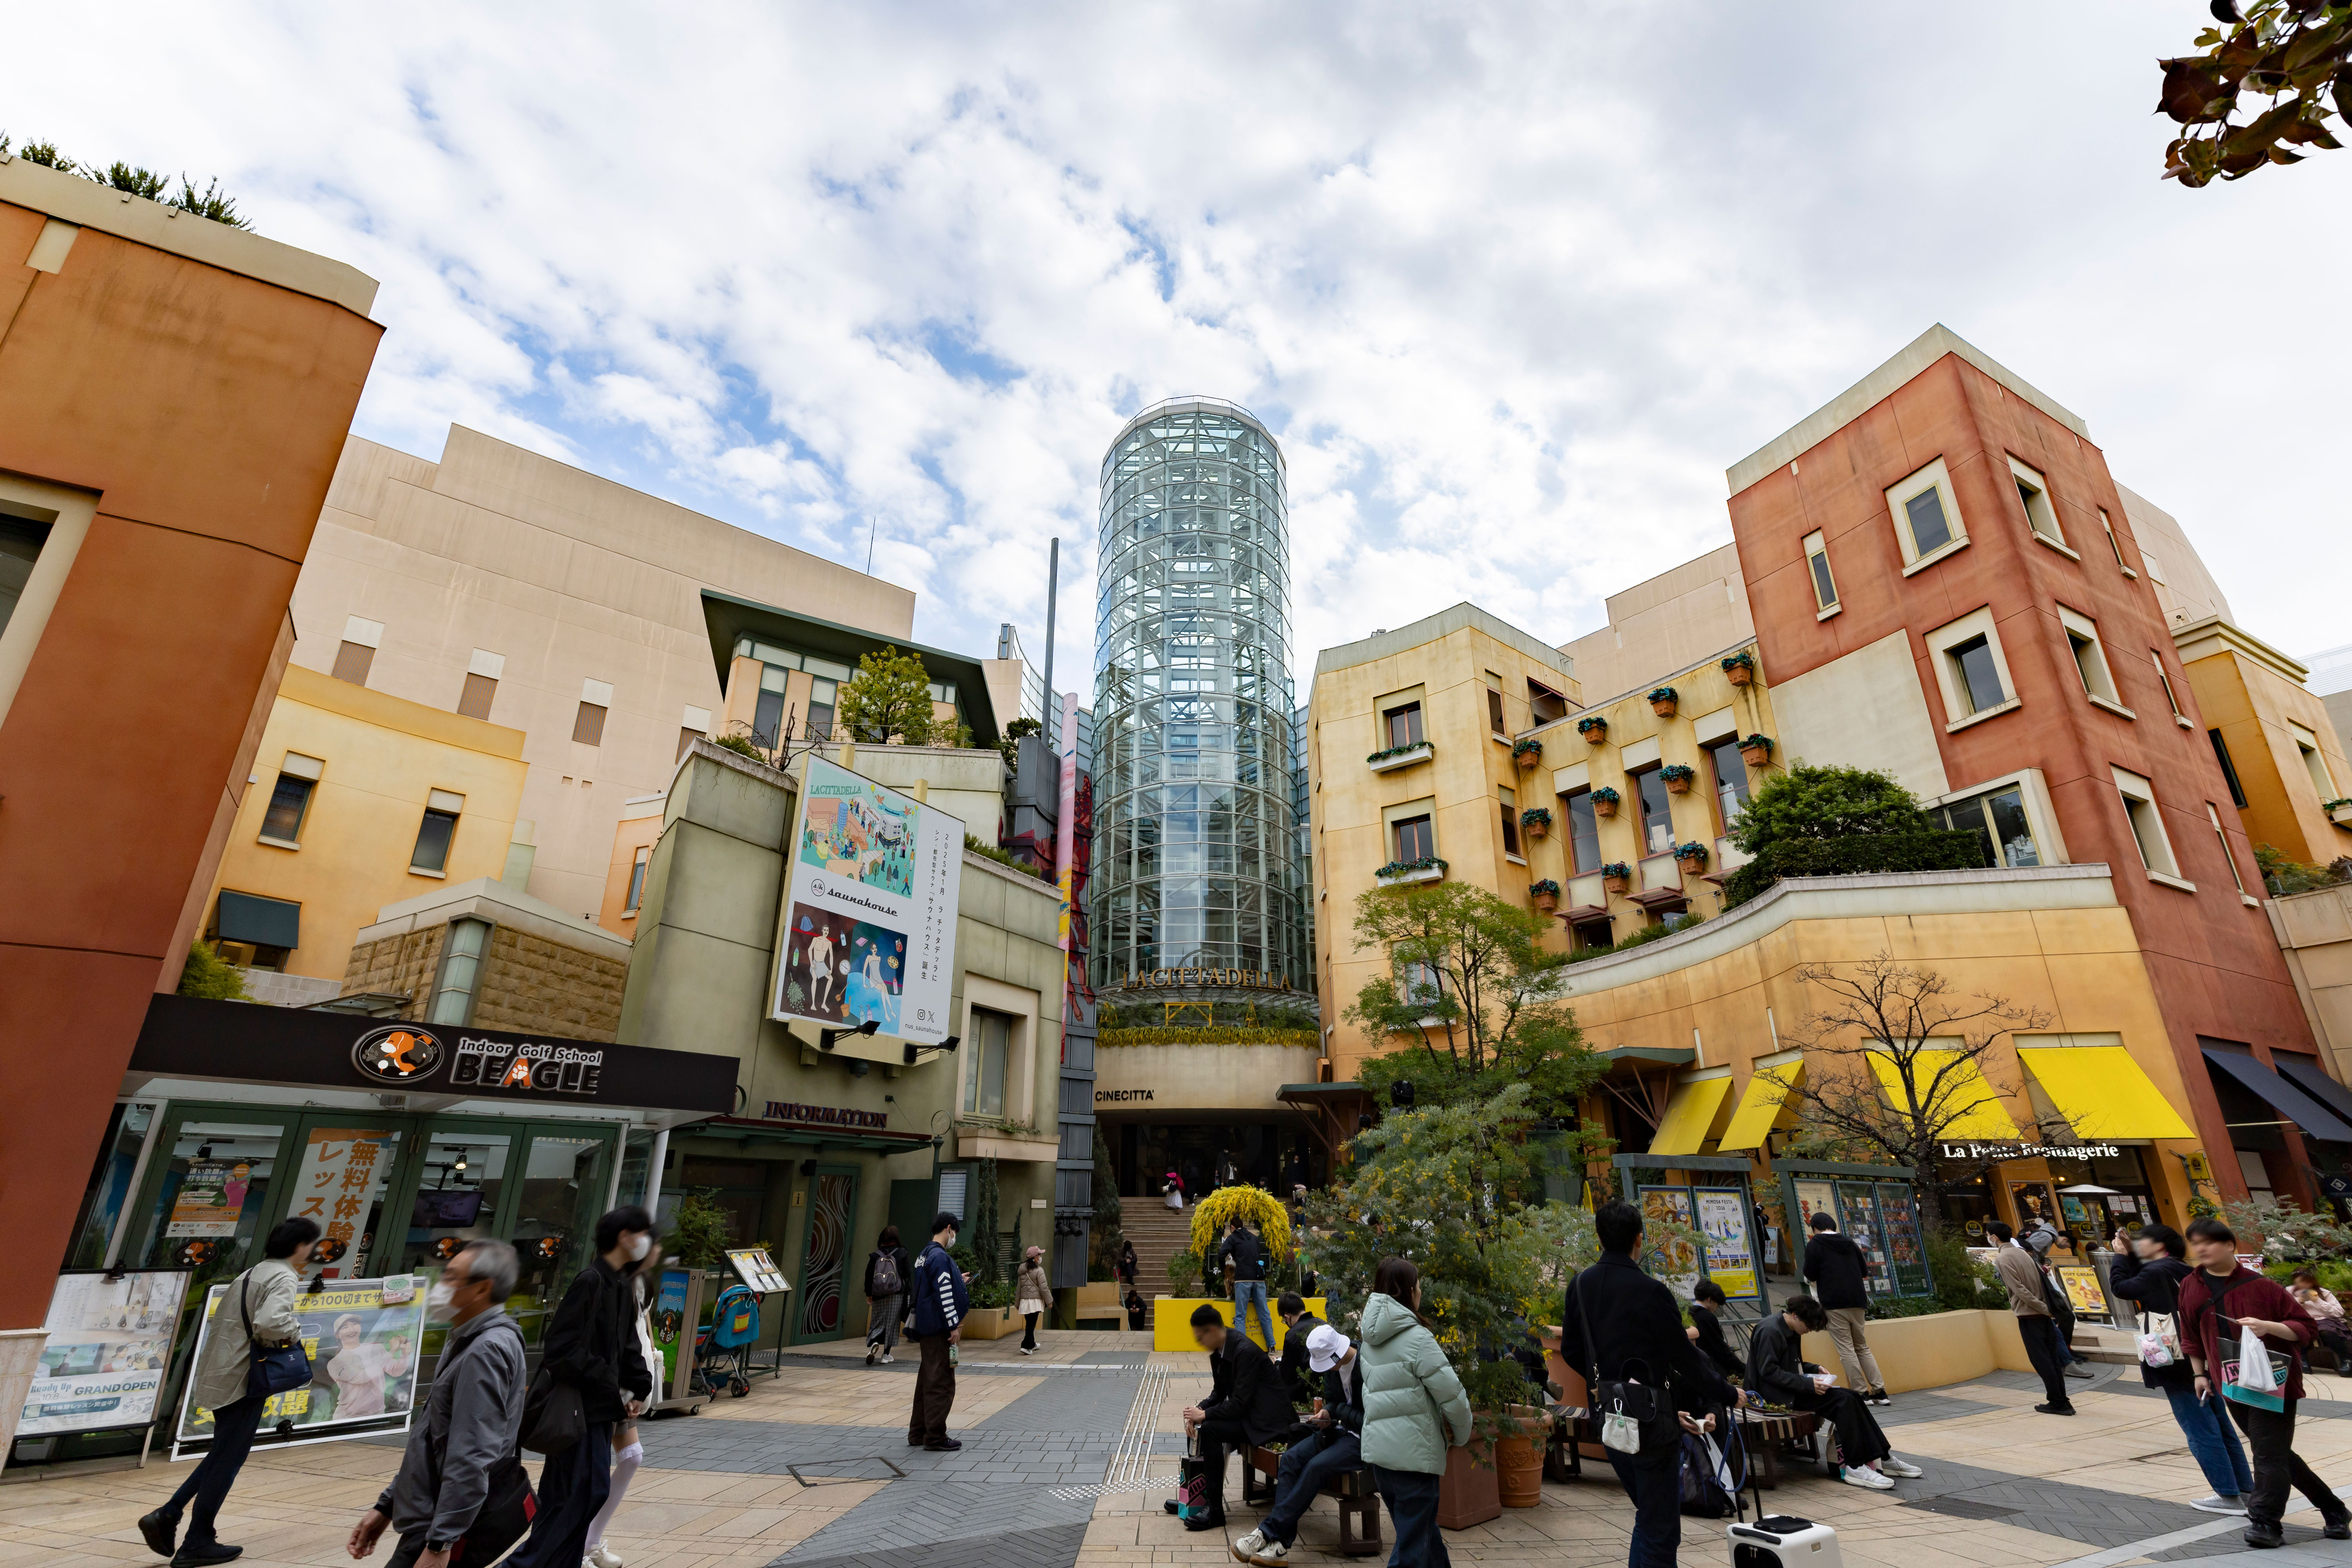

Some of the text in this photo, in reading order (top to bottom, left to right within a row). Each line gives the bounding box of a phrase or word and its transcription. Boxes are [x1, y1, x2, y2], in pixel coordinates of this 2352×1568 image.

[827, 888, 898, 916] saunahouse
[932, 834, 949, 982] 2025年1月 ラチッタデッラに
[905, 1023, 942, 1035] nus_saunahouse
[460, 1039, 601, 1063] Indoor Golf School
[452, 1052, 601, 1093] BEAGLE
[764, 1100, 889, 1128] INFORMATION
[1943, 1144, 1966, 1158] La
[326, 1140, 380, 1247] 無料体験
[659, 1329, 675, 1343] BEAGLE
[41, 1393, 59, 1401] 10.8
[61, 1383, 71, 1392] Up
[74, 1381, 157, 1396] GRAND OPEN
